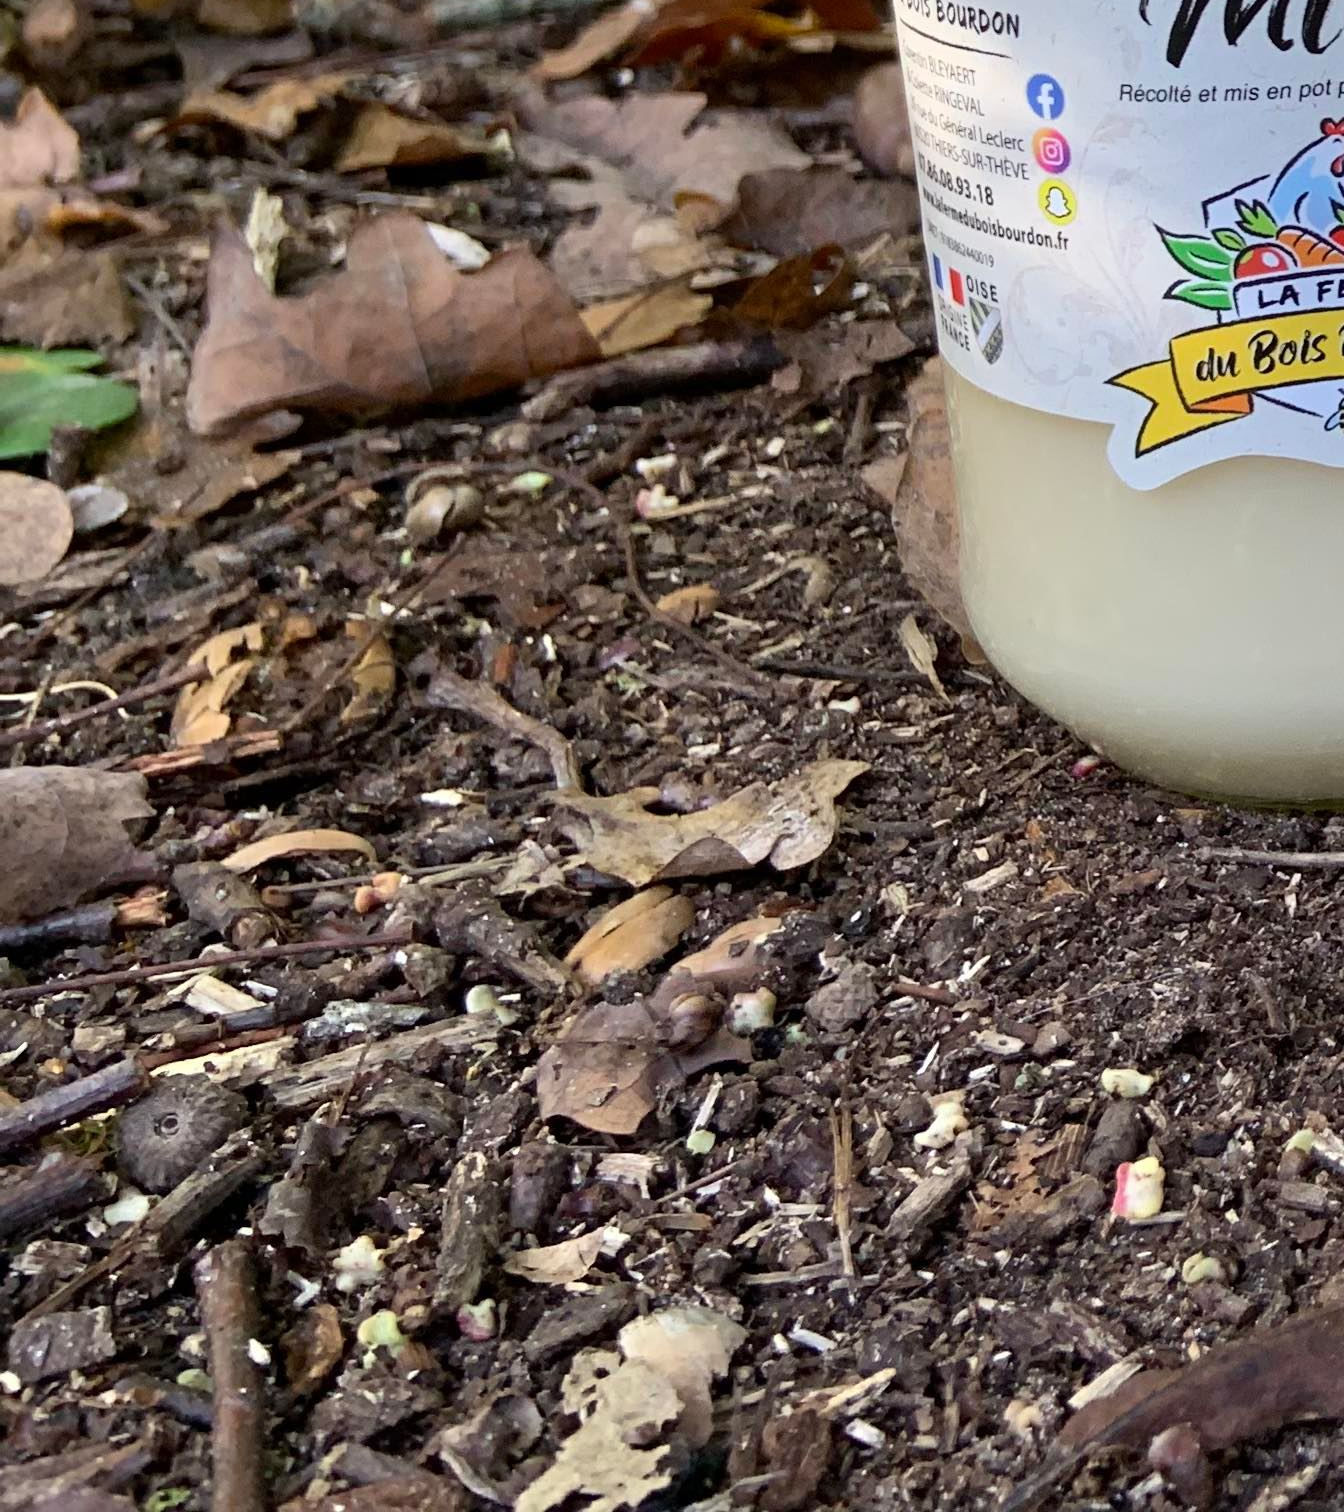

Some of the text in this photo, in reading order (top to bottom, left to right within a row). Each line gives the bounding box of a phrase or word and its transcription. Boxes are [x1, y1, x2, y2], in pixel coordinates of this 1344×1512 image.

[929, 54, 976, 87] BLEYAERT
[934, 78, 985, 117] RINGEVAL
[1119, 82, 1192, 104] Récolté
[1199, 86, 1217, 103] et
[1224, 83, 1260, 103] mis
[1266, 84, 1292, 101] en
[1298, 79, 1332, 104] pot
[939, 114, 976, 142] Général
[980, 126, 1024, 152] Leclerc
[930, 129, 1030, 180] THIERS-SUR-THÈVE
[965, 274, 999, 303] OISE
[1257, 283, 1300, 309] LA
[940, 314, 972, 354] FRANCE
[1195, 347, 1241, 382] du
[1247, 328, 1327, 375] Bois
